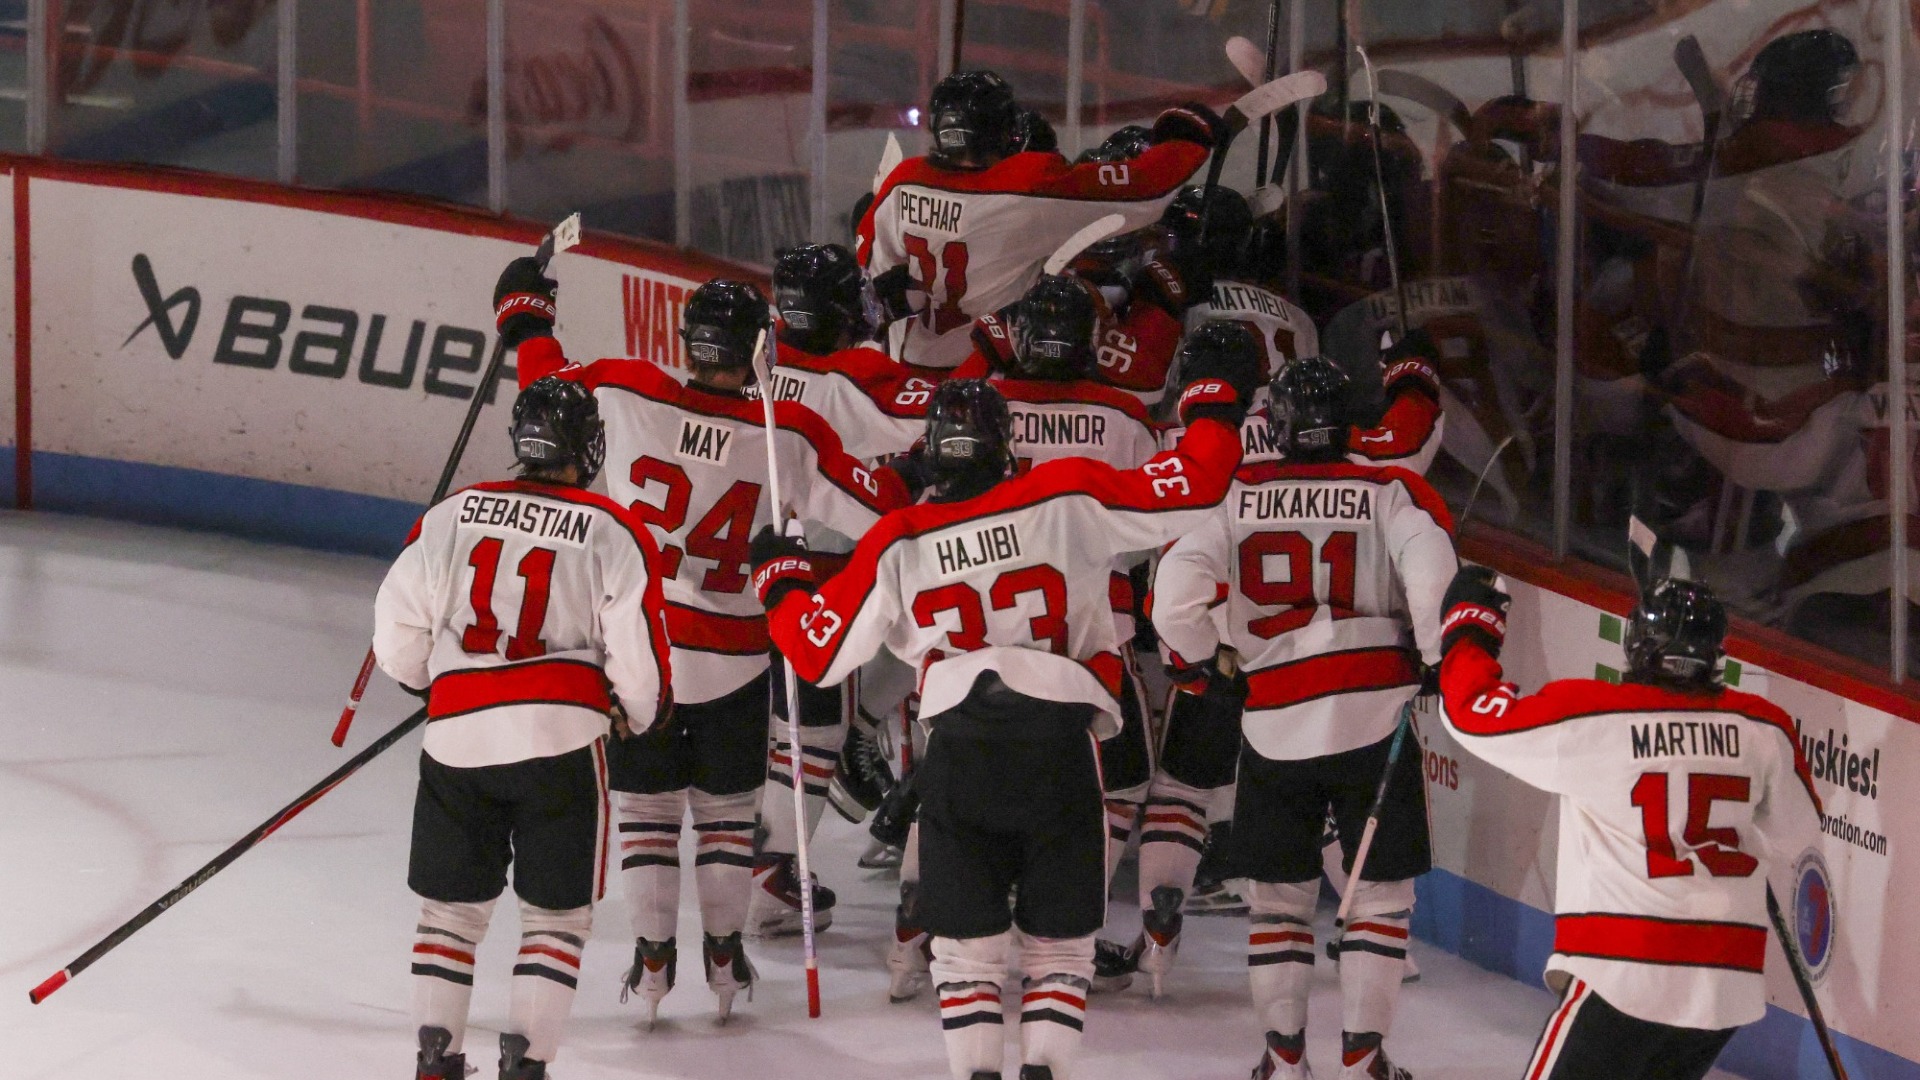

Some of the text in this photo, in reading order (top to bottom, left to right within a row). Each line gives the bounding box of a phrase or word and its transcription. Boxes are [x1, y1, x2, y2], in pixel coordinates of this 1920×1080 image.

[901, 190, 963, 234] PECHAR
[621, 273, 697, 370] WAT
[1209, 285, 1289, 322] MATHIEU
[680, 422, 731, 462] MAY
[1011, 411, 1106, 446] CONNOR
[1143, 457, 1191, 498] 33
[460, 495, 593, 544] SEBASTIAN
[629, 454, 762, 594] 24
[1239, 488, 1371, 521] FUKAKUSA
[936, 523, 1021, 575] HAJIBI
[462, 536, 556, 661] 11
[911, 563, 1069, 657] 33
[1238, 531, 1358, 641] 91
[1631, 722, 1740, 760] MARTINO
[1630, 772, 1760, 879] 15
